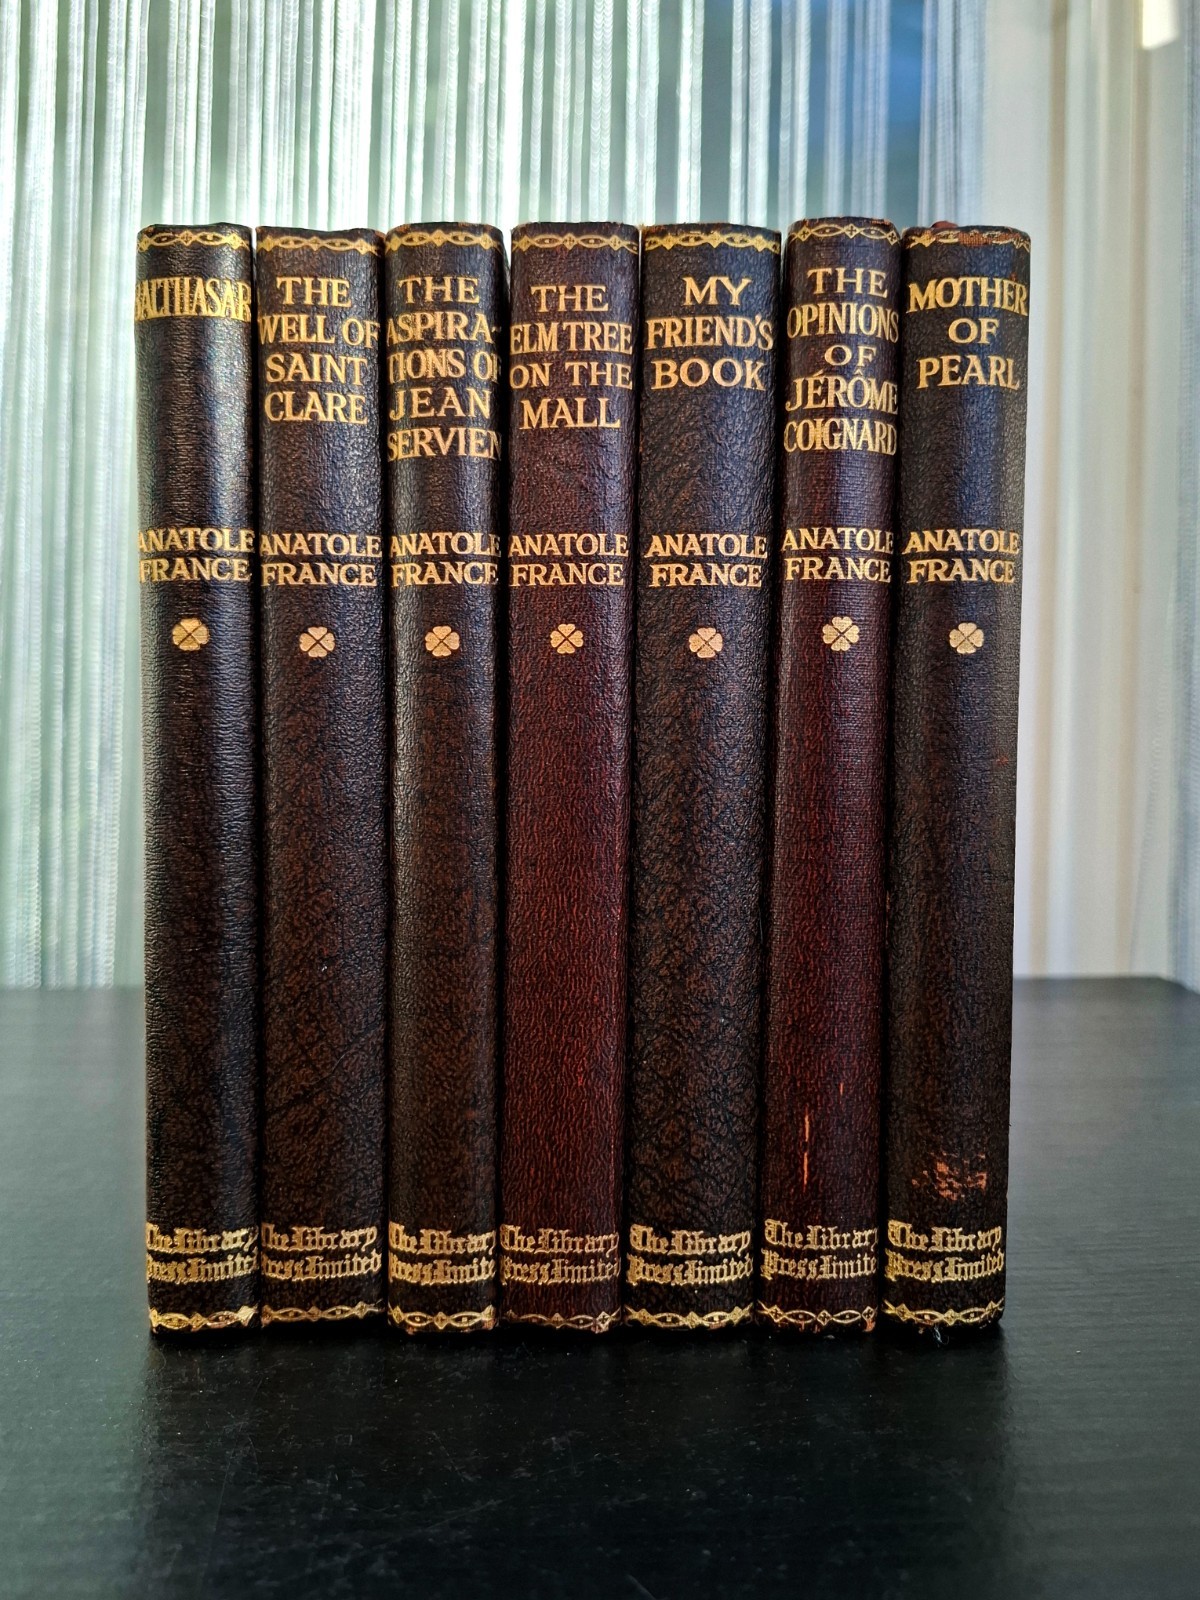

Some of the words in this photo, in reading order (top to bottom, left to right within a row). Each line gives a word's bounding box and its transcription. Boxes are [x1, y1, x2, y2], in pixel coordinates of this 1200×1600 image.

[277, 276, 352, 308] THE
[399, 276, 480, 304] THE
[531, 285, 609, 312] THE
[682, 276, 752, 306] MY
[807, 268, 888, 299] THE
[906, 276, 1029, 317] MOTHER
[258, 315, 335, 345] WELL
[342, 318, 380, 349] OF
[510, 322, 558, 355] ELM
[562, 322, 633, 355] TREE
[645, 314, 774, 351] FRIEND'S
[786, 302, 899, 343] OPINIONS
[948, 317, 1000, 344] OF
[265, 353, 368, 386] SAINT
[824, 345, 877, 367] OF
[510, 362, 552, 390] ON
[565, 361, 633, 390] THE
[651, 357, 766, 391] BOOK
[916, 355, 1020, 391] PEARL
[264, 391, 368, 424] CLARE
[389, 386, 492, 421] JEAN
[785, 369, 898, 415] JÉRÔME
[519, 398, 621, 430] MALL
[388, 427, 502, 462] SERVIEN
[783, 418, 897, 456] COIGNARD
[138, 527, 256, 553] ANATOLE
[260, 532, 383, 558] ANATOLE
[389, 531, 502, 558] ANATOLE
[508, 533, 629, 558] ANATOLE
[644, 533, 768, 559] ANATOLE
[781, 527, 894, 555] ANATOLE
[902, 528, 1021, 555] ANATOLE
[139, 557, 252, 583] FRANCE
[261, 562, 377, 587] FRANCE
[390, 561, 498, 587] FRANCE
[510, 562, 624, 587] FRANCE
[649, 562, 762, 588] FRANCE
[784, 556, 892, 583] FRANCE
[907, 558, 1016, 584] FRANCE
[172, 1225, 259, 1254] Library
[288, 1225, 378, 1252] Library
[389, 1221, 417, 1254] The
[416, 1229, 497, 1256] Library
[500, 1223, 536, 1254] The
[534, 1227, 620, 1258] Library
[629, 1223, 669, 1255] The
[667, 1229, 751, 1257] Library
[764, 1218, 804, 1249] The
[802, 1225, 879, 1252] Library
[887, 1219, 929, 1251] The
[928, 1226, 1003, 1252] Library
[302, 1248, 382, 1282] Limited
[499, 1254, 551, 1286] Press
[626, 1252, 685, 1286] Press
[683, 1252, 754, 1286] Limited
[760, 1247, 818, 1281] Press
[884, 1247, 944, 1283] Press
[942, 1248, 1005, 1282] Limited
